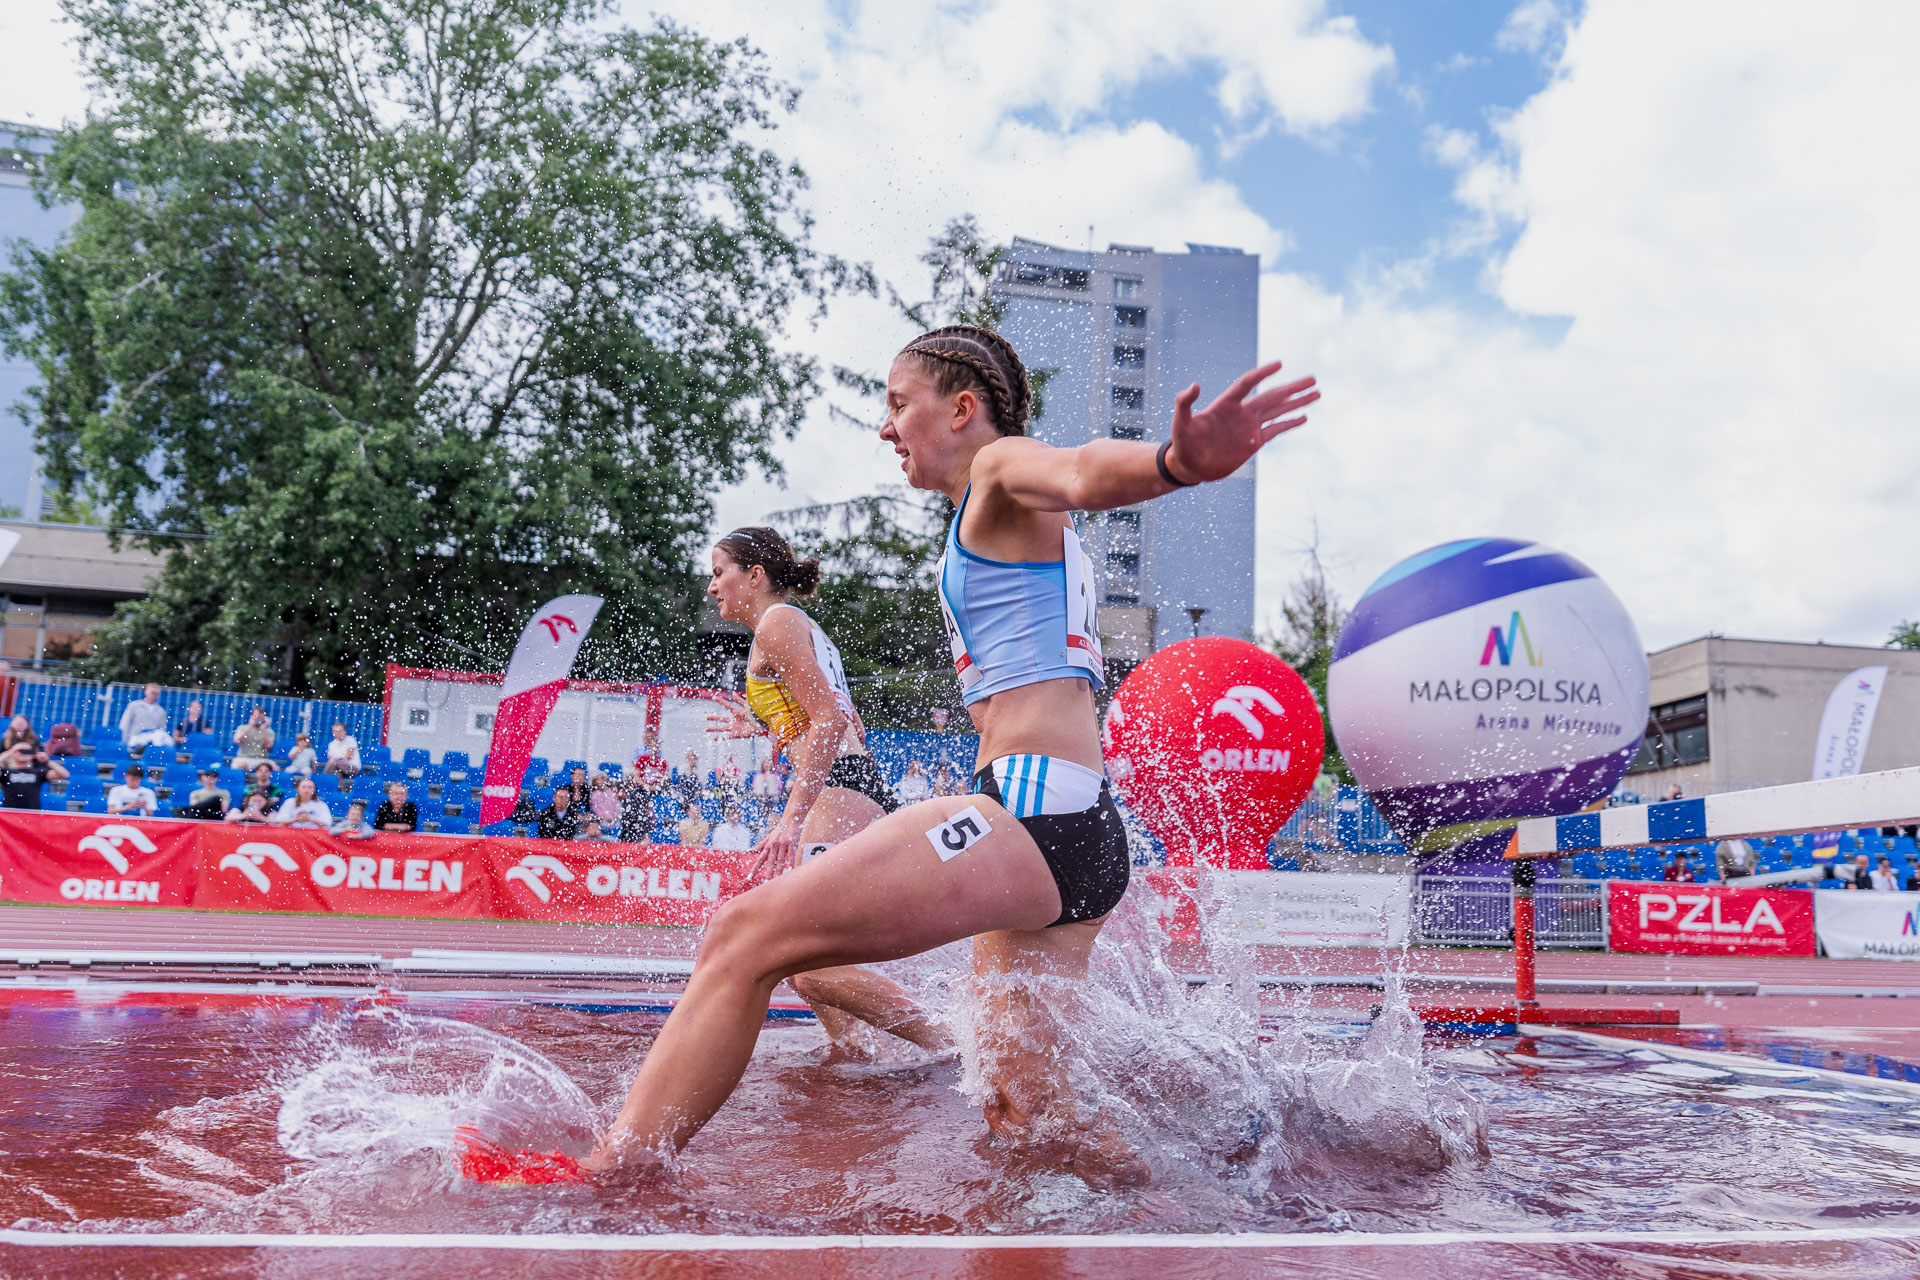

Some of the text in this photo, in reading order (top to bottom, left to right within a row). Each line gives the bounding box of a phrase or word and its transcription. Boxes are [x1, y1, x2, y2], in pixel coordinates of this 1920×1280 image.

[1410, 678, 1602, 705] MAŁOPOLSKA
[1476, 713, 1530, 731] Arena
[1201, 748, 1291, 771] ORLEN
[941, 816, 981, 851] 5
[310, 854, 463, 893] ORLEN
[587, 865, 721, 900] ORLEN
[60, 878, 160, 902] ORLEN
[1639, 893, 1785, 934] PZLA
